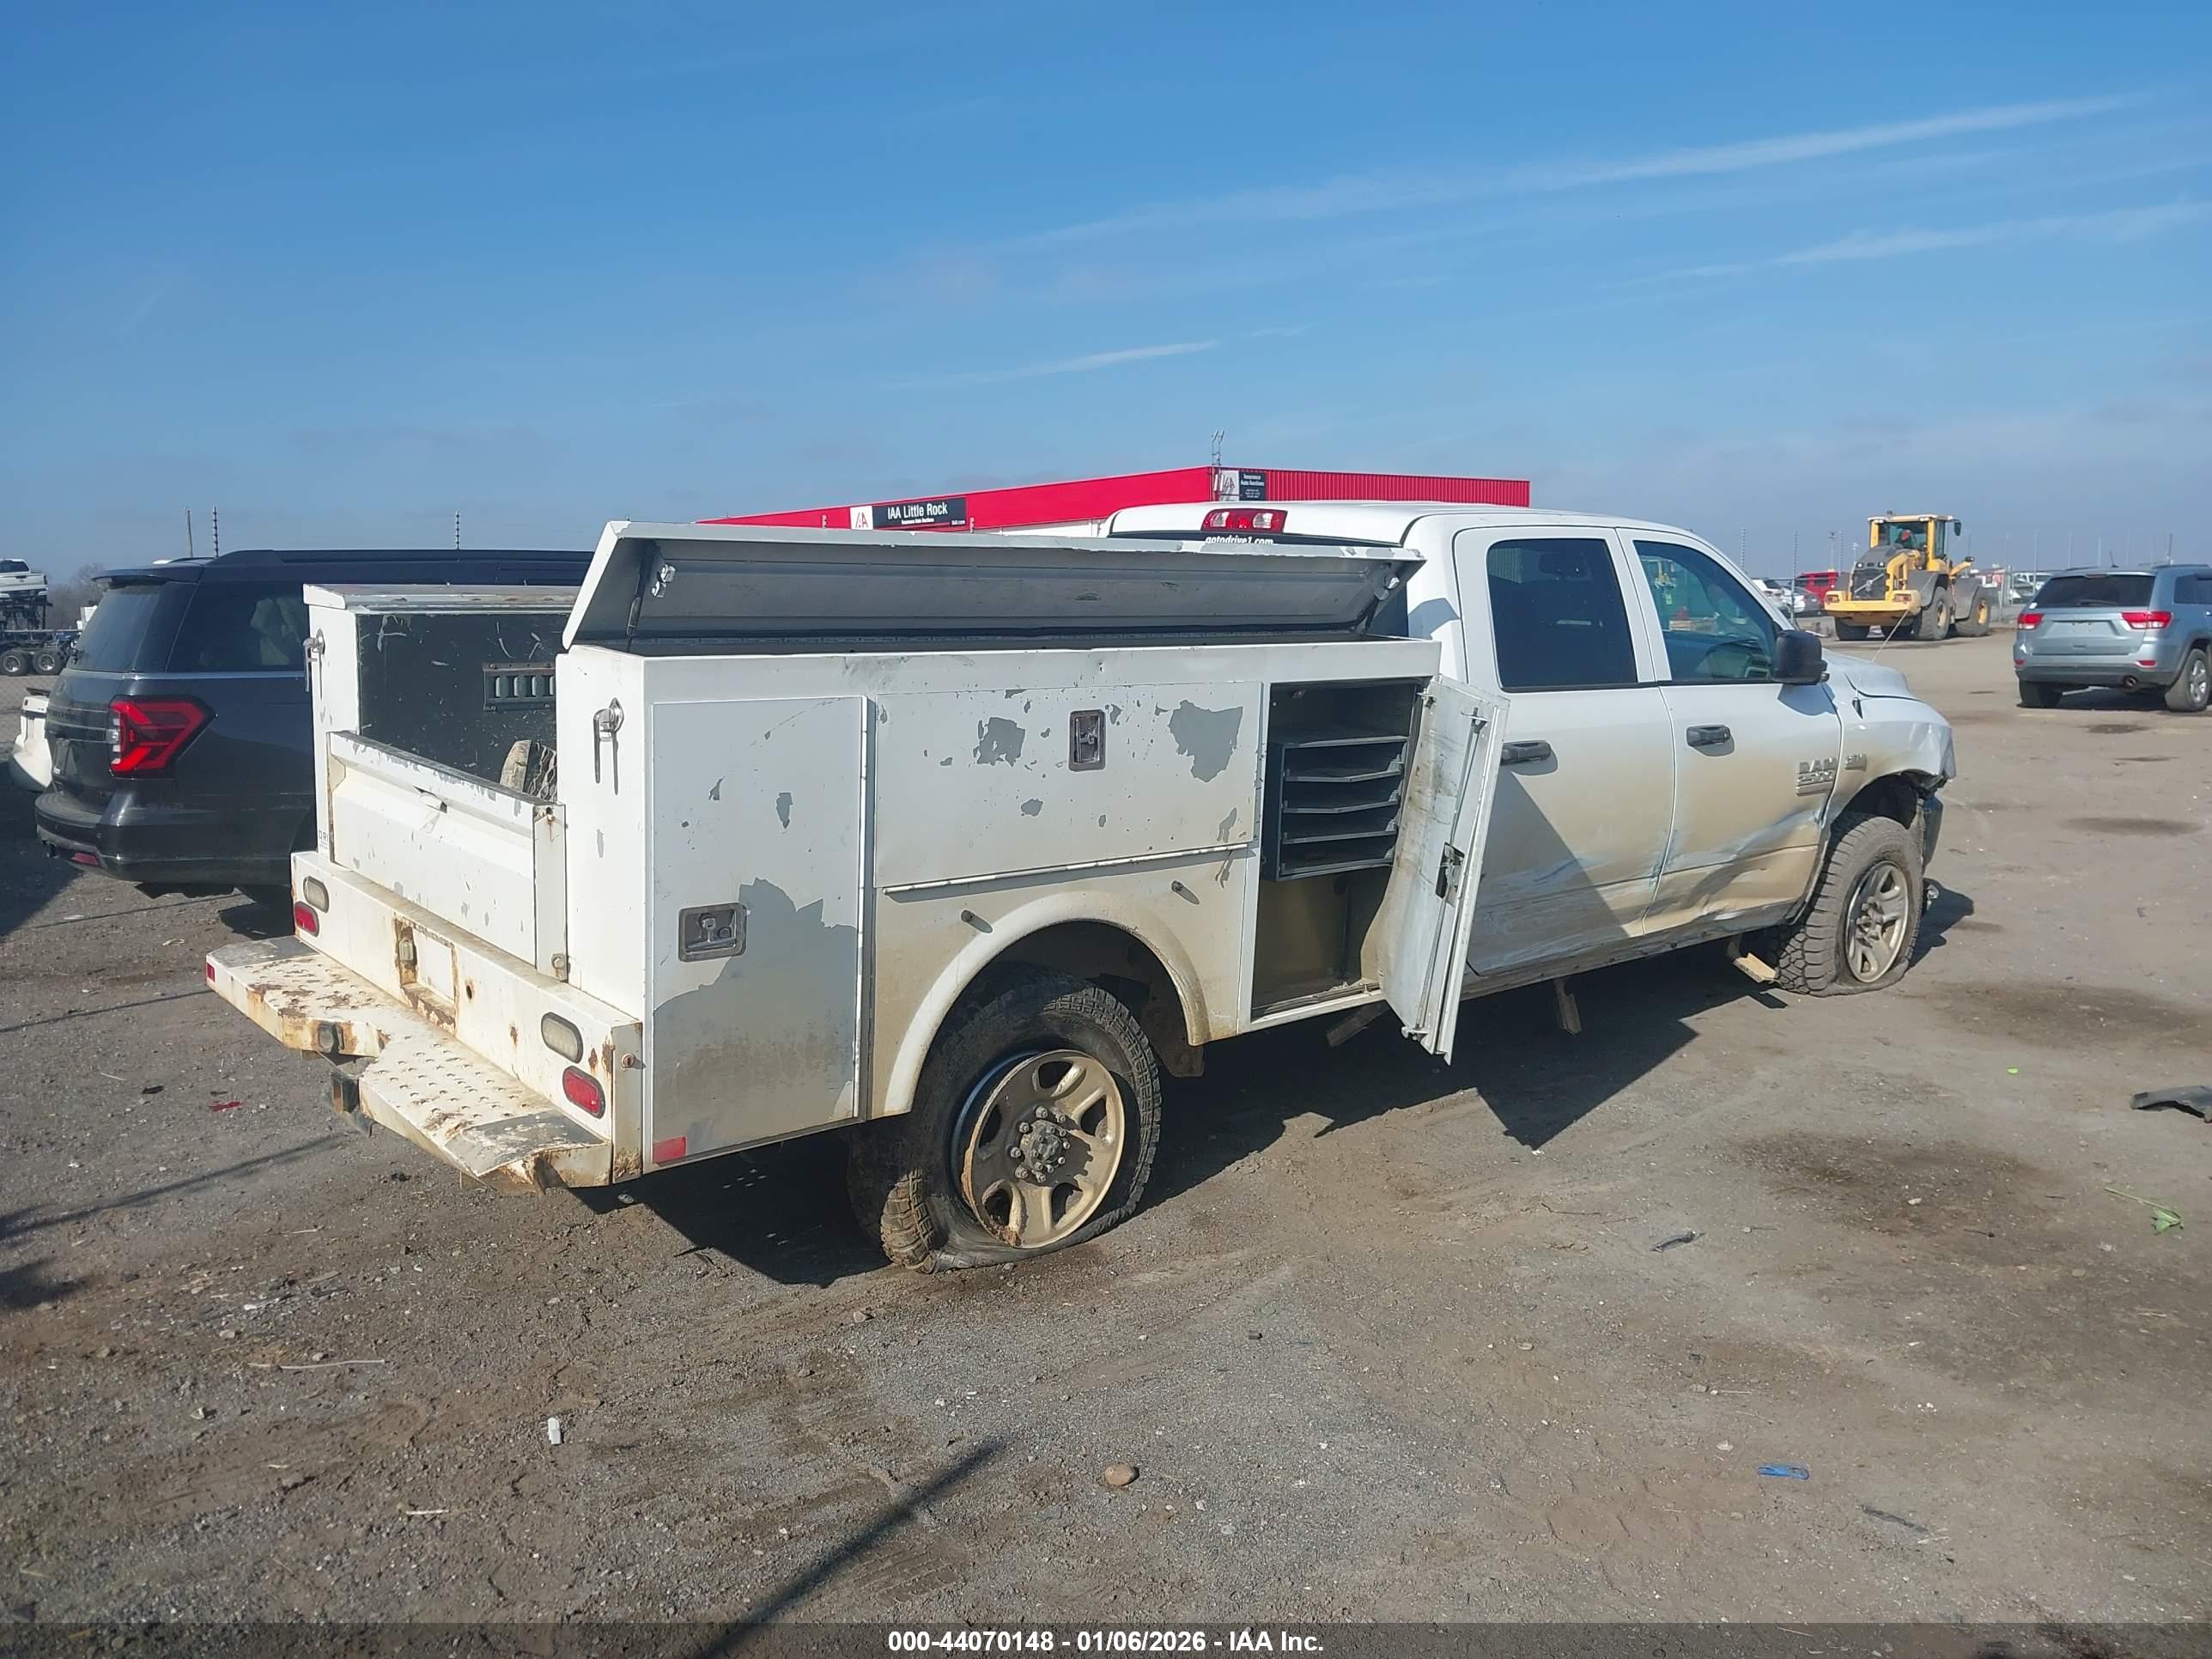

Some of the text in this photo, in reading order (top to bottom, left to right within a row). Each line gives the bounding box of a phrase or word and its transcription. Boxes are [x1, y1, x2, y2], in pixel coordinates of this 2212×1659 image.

[887, 502, 948, 520] IAA Little Rock
